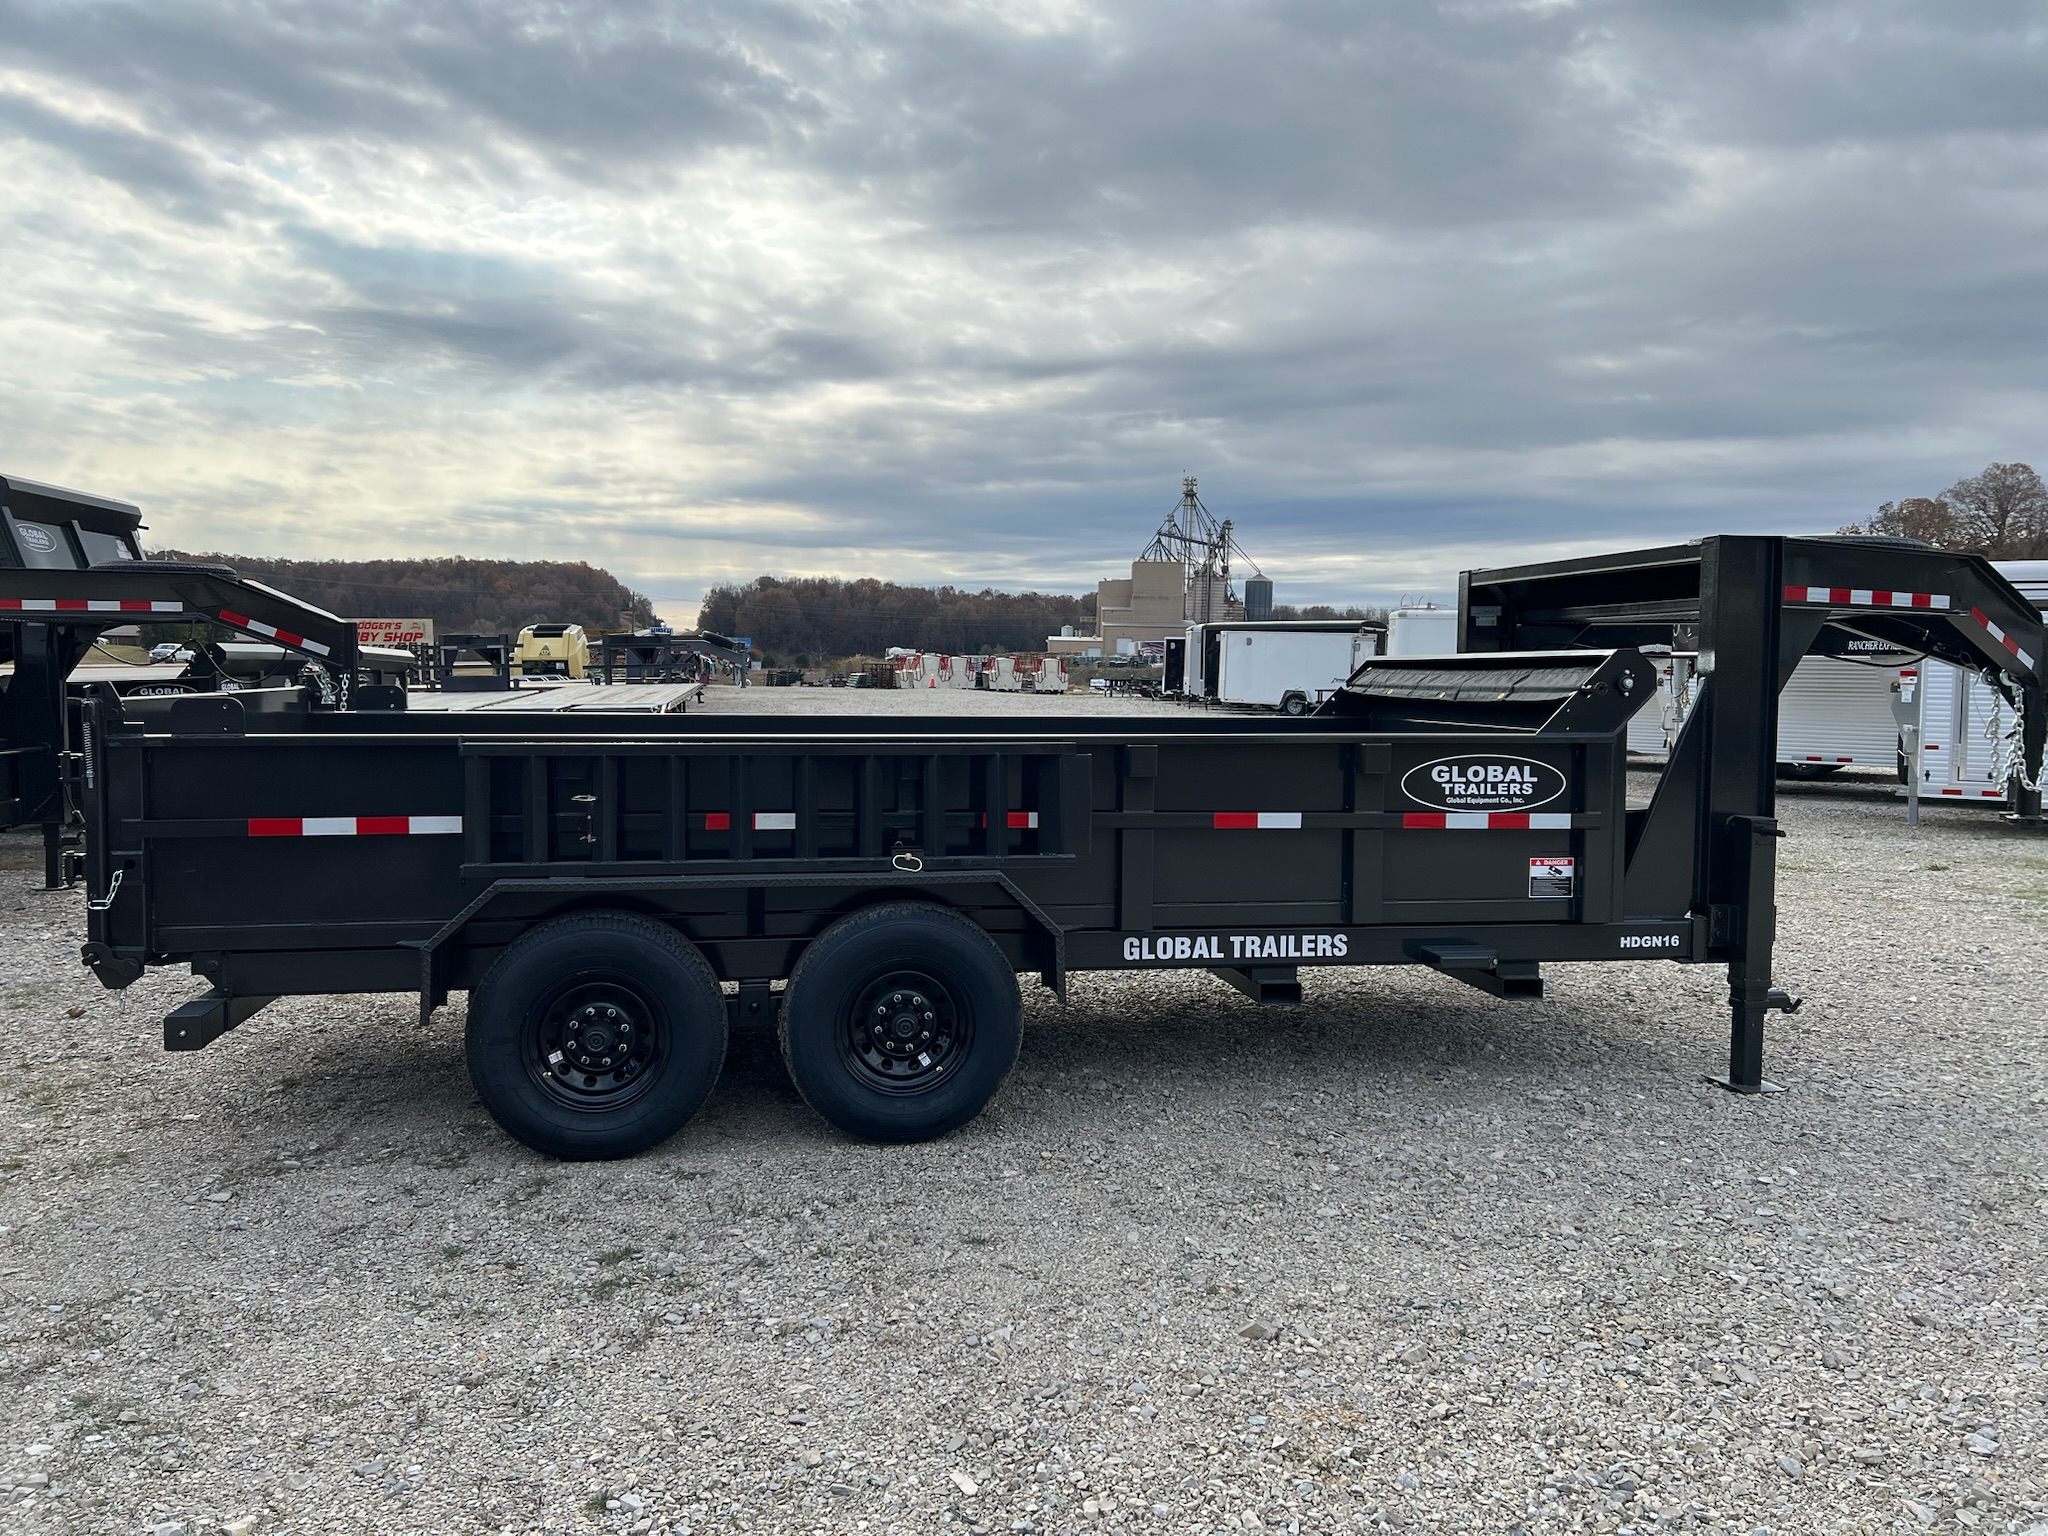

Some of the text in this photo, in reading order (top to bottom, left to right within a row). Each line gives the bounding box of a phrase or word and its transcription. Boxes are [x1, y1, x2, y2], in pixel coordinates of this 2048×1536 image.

[19, 527, 48, 540] GLOBAL
[357, 621, 402, 630] ODGER'S
[357, 632, 424, 642] BY SHOP
[1848, 640, 1879, 651] RANCHER
[140, 687, 184, 696] GLOBAL
[221, 683, 240, 691] GLOBAL
[1431, 765, 1538, 783] GLOBAL
[1441, 783, 1533, 795] TRAILERS
[1467, 797, 1499, 805] Equipment
[1123, 934, 1348, 960] GLOBAL TRAILERS
[1620, 935, 1680, 948] HDGN16
